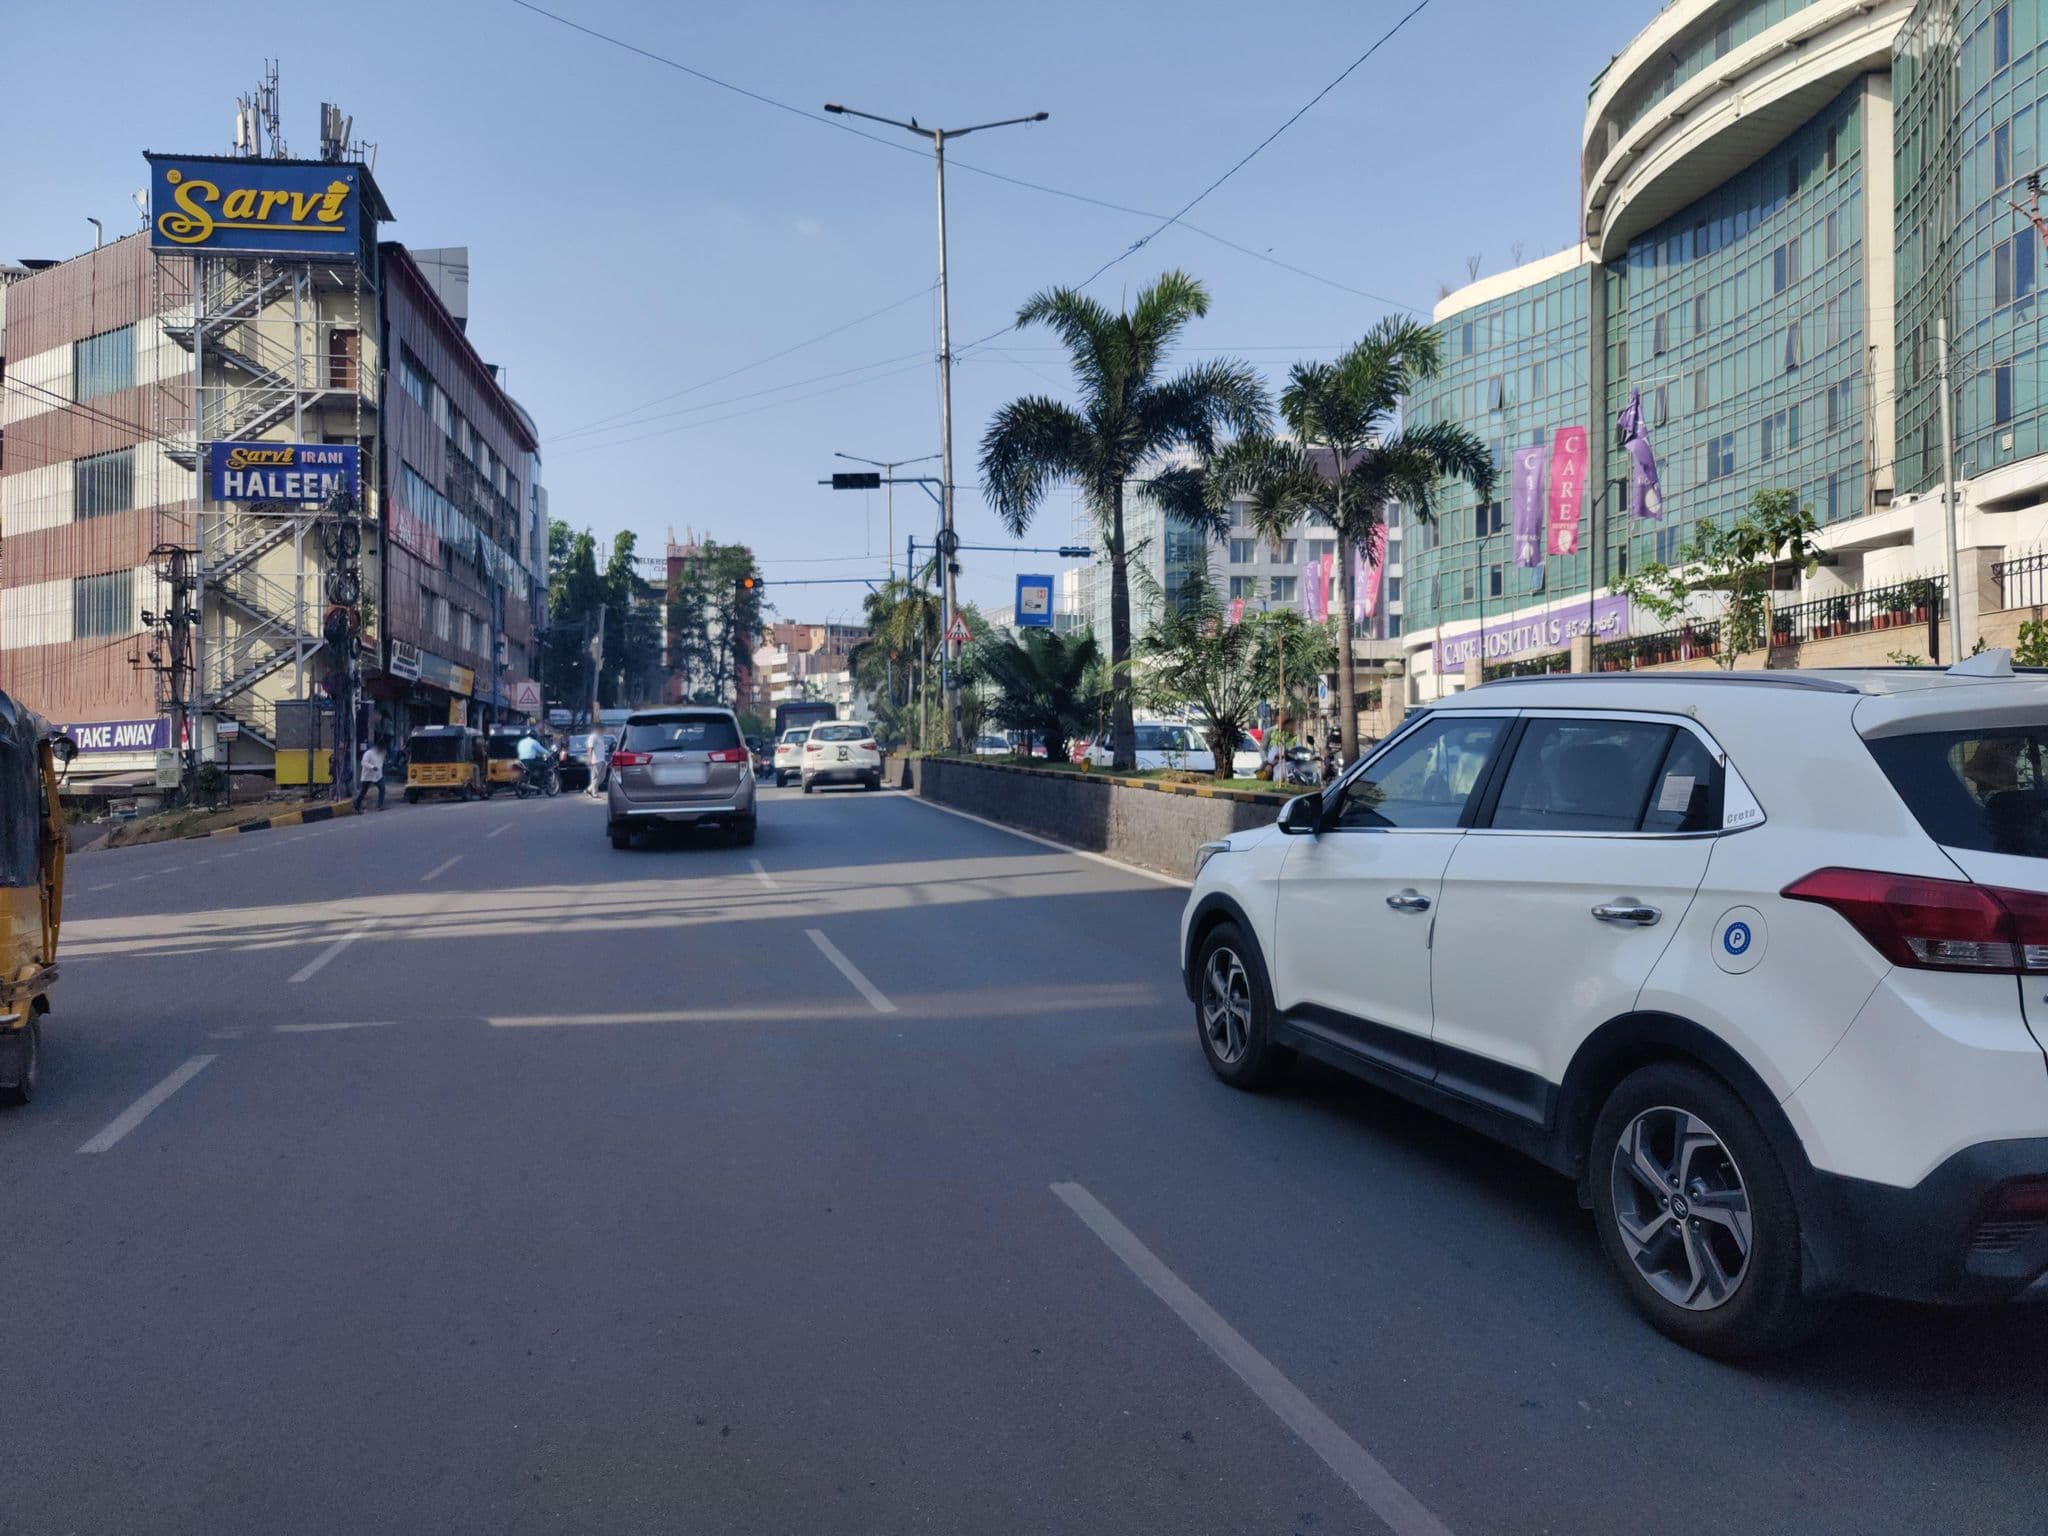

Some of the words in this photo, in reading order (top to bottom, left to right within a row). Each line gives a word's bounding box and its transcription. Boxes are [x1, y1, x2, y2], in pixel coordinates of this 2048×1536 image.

[158, 180, 350, 243] Sarvi
[226, 447, 294, 470] Sarvi
[301, 451, 343, 464] IRANI
[1560, 436, 1579, 521] CARE
[1444, 637, 1476, 666] CARE
[1477, 619, 1561, 659] HOSPITALS
[75, 727, 111, 749] TAKE
[114, 723, 156, 747] AWAY
[1733, 932, 1742, 945] P
